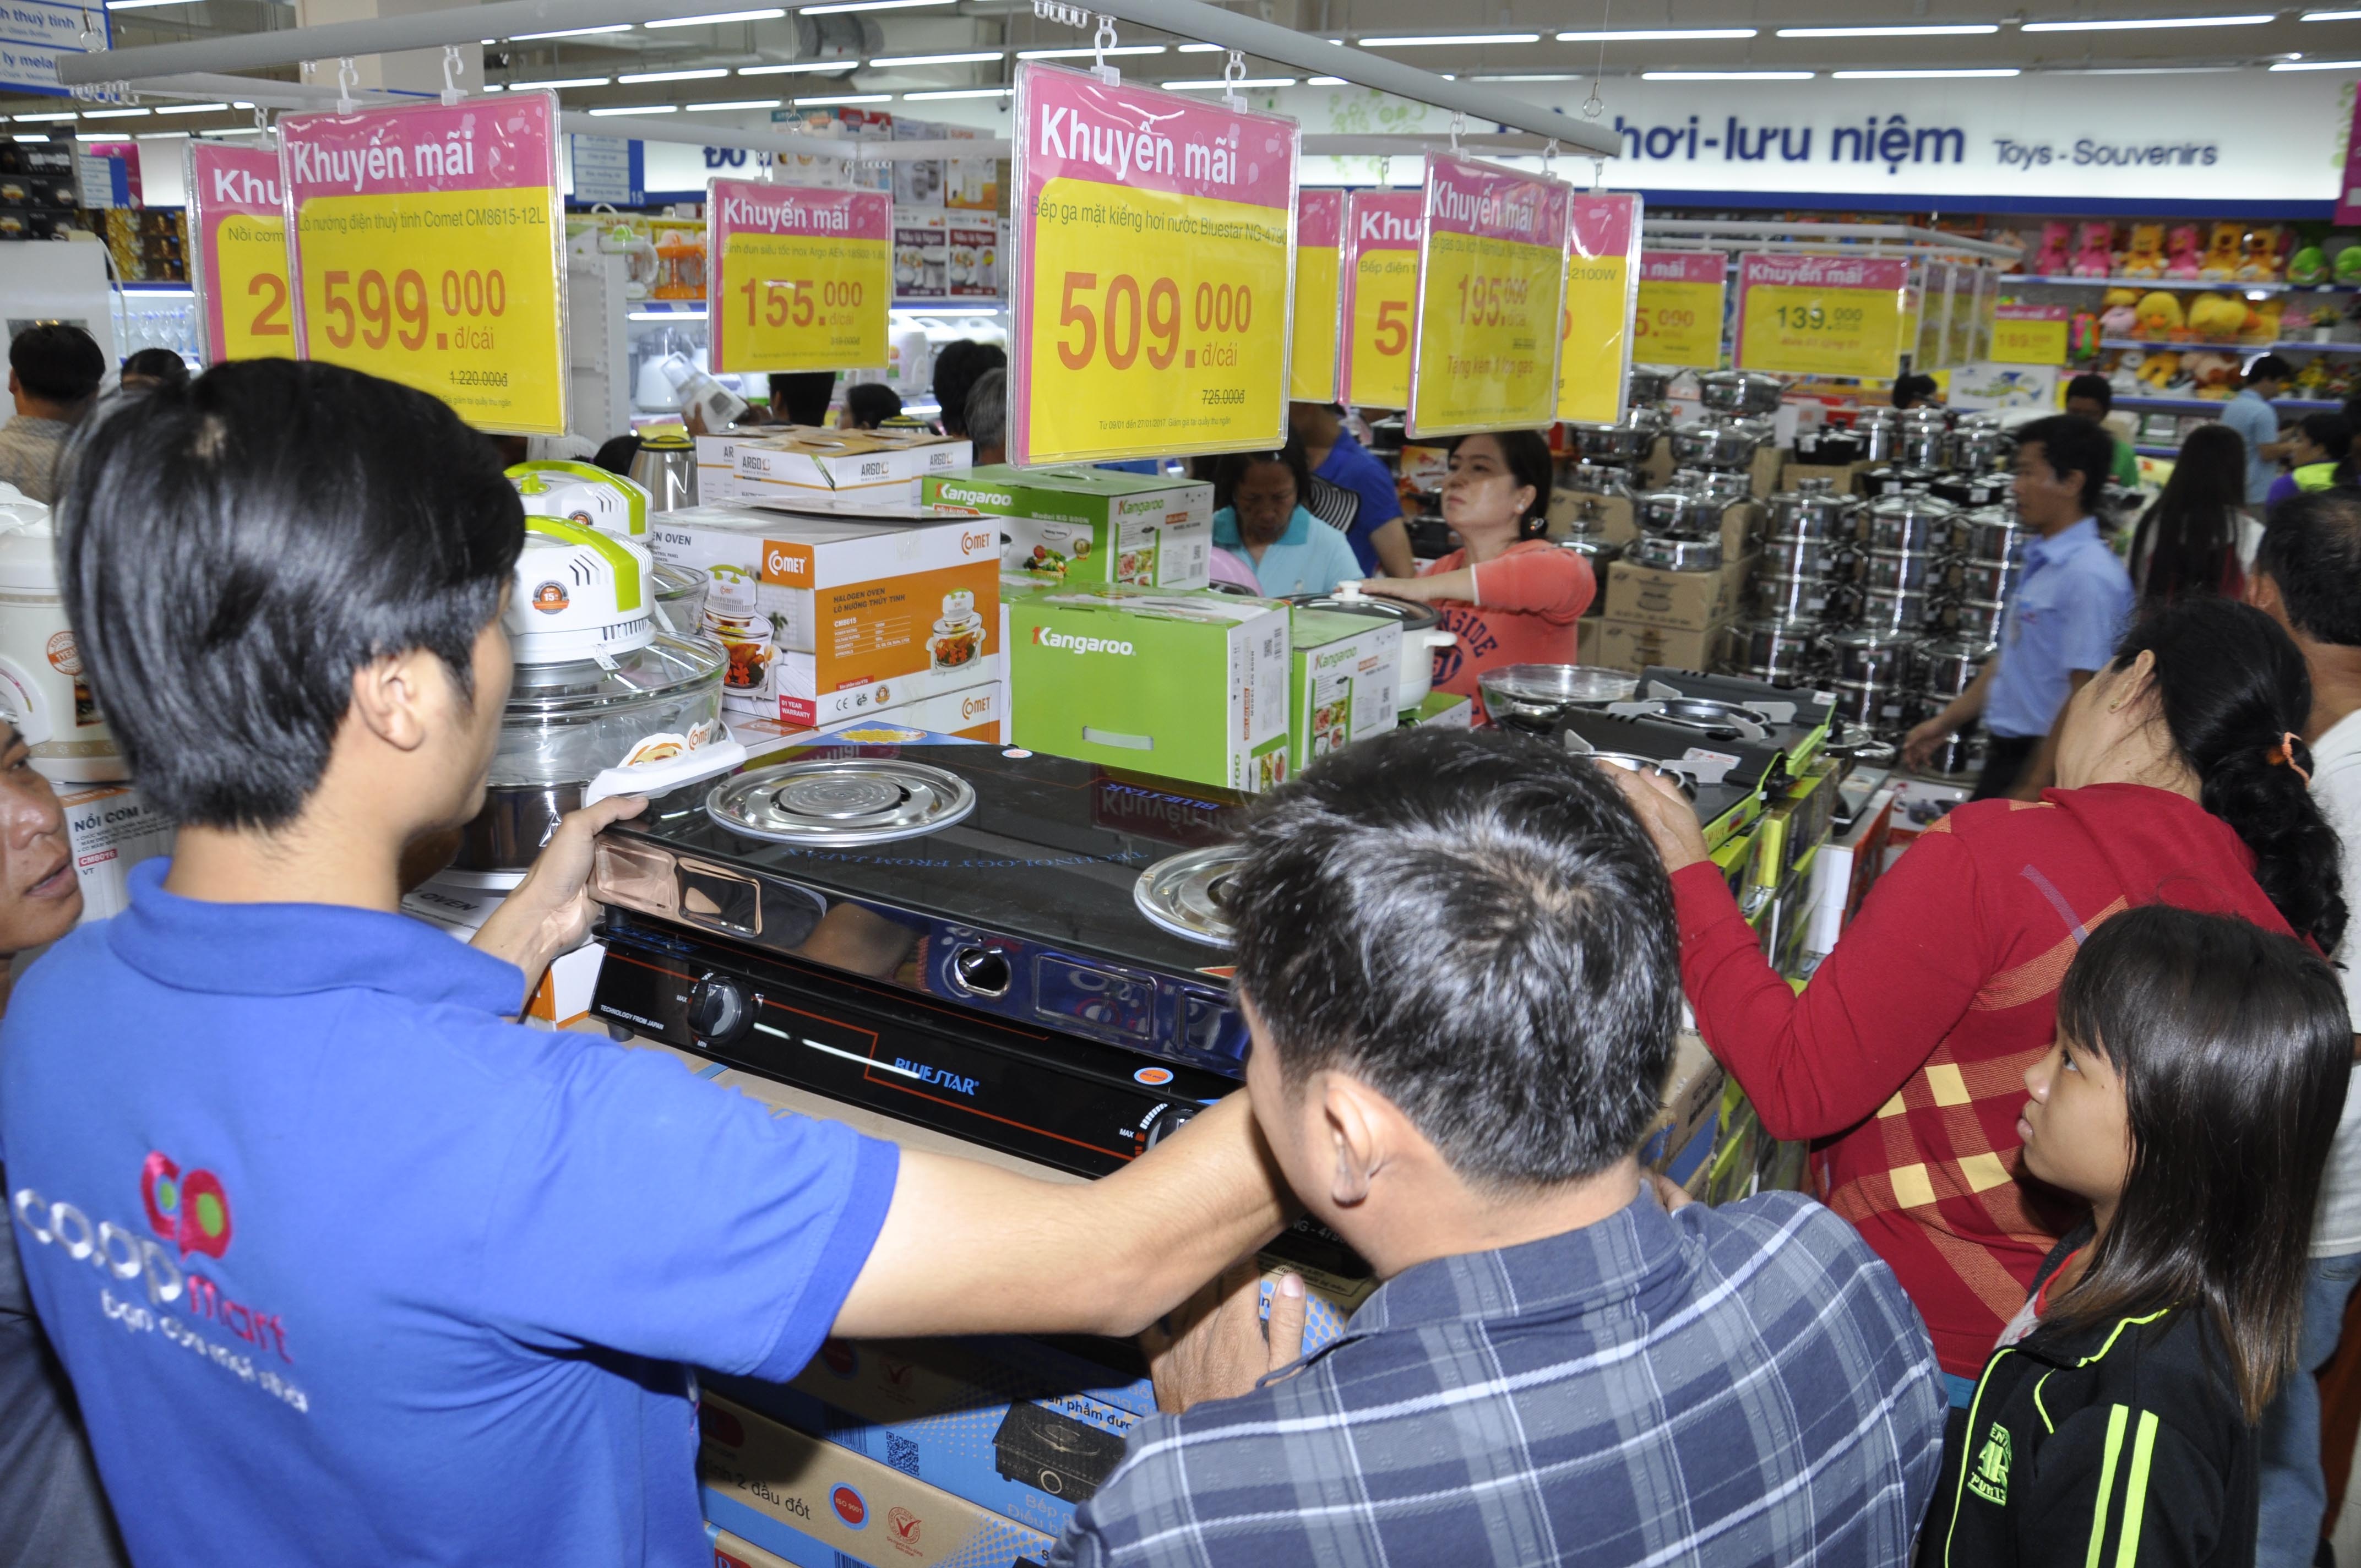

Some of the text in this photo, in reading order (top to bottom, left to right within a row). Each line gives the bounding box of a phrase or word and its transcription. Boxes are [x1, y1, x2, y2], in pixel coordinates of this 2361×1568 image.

[1040, 104, 1236, 185] Khuyến mãi
[1614, 113, 1965, 175] hơi-lưu niệm
[293, 129, 475, 192] Khuyến mãi
[423, 209, 464, 228] Comet
[465, 207, 546, 227] CM8615-12L
[724, 197, 850, 233] Khuyến mãi
[1031, 194, 1058, 223] Bếp
[1061, 208, 1078, 225] ga
[1081, 205, 1106, 228] mặt
[1146, 209, 1165, 230] hơi
[1167, 213, 1198, 235] nước
[1200, 217, 1243, 239] Bluestar
[1374, 301, 1408, 356] 5
[1202, 341, 1238, 368] đ/cái
[742, 455, 762, 470] ARGO
[861, 462, 880, 476] ARGO
[930, 453, 946, 466] ARGO
[935, 483, 1012, 507] Kangaroo
[665, 533, 692, 546] OVEN
[961, 531, 991, 556] COMET
[768, 549, 806, 577] COMET
[834, 587, 885, 603] HALOGEN OVEN
[889, 594, 906, 603] TINH
[1031, 626, 1134, 655] Kangaroo
[782, 707, 810, 719] WARRANTY
[788, 700, 802, 709] YEAR
[961, 695, 991, 720] COMET
[74, 813, 102, 832] NỒI
[420, 893, 480, 911] OVEN
[676, 994, 688, 1003] MAX
[600, 1004, 665, 1030] TECHNOLOGY FROM JAPAN
[697, 1039, 708, 1048] MIN
[1119, 1128, 1134, 1139] MAX
[1067, 1402, 1103, 1421] phẩm
[738, 1473, 747, 1490] 2
[785, 1498, 811, 1520] đốt
[835, 1497, 863, 1514] ISO 9001
